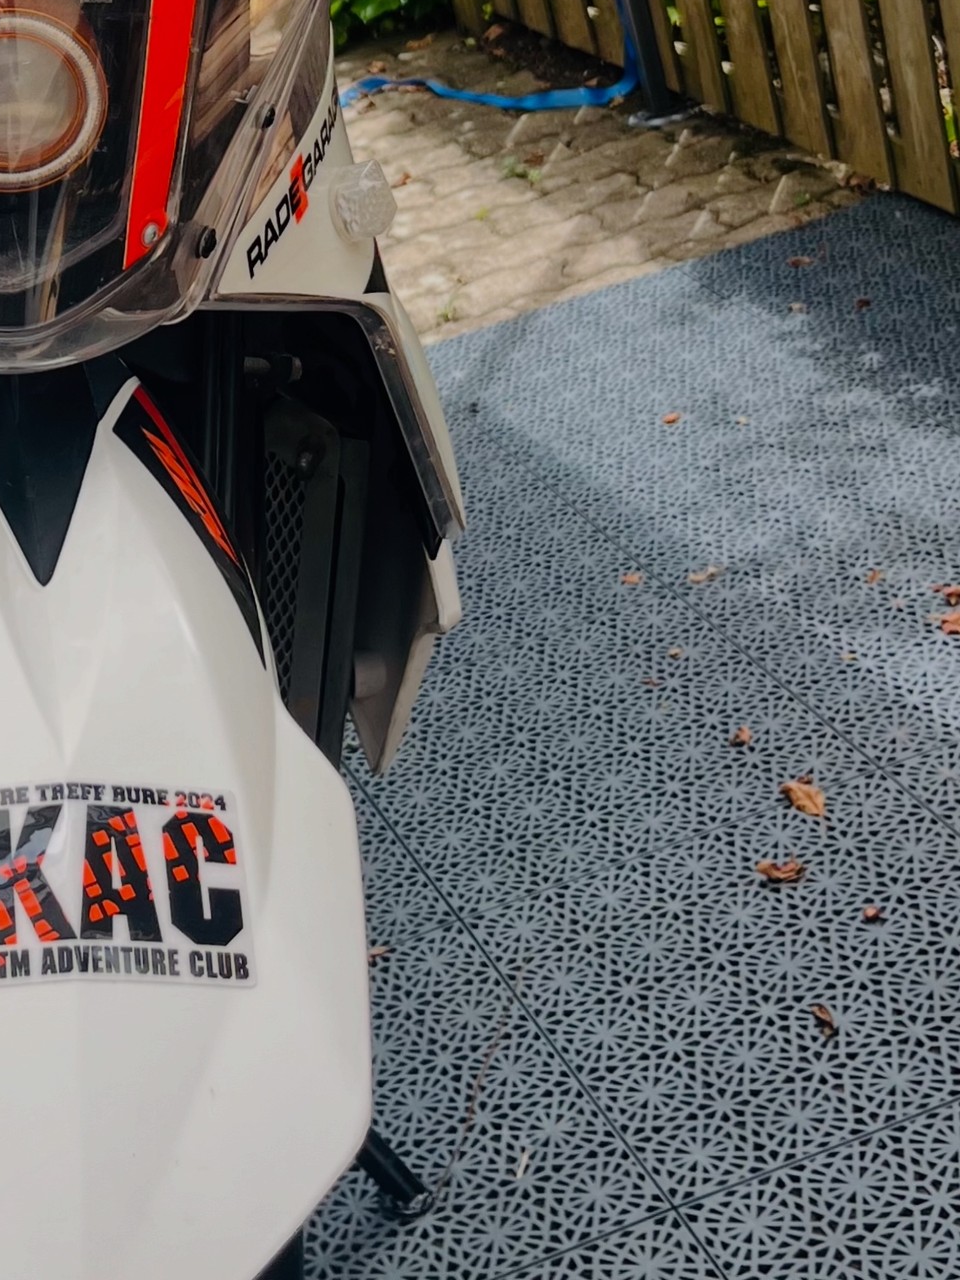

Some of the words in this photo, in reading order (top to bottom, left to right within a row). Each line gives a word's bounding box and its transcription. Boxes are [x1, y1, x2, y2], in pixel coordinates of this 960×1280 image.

[246, 175, 302, 280] RADE
[301, 77, 339, 193] GARAG
[35, 782, 107, 802] TREFF
[173, 793, 228, 812] 2024
[41, 945, 181, 977] ADVENTURE
[189, 950, 250, 981] CLUB
